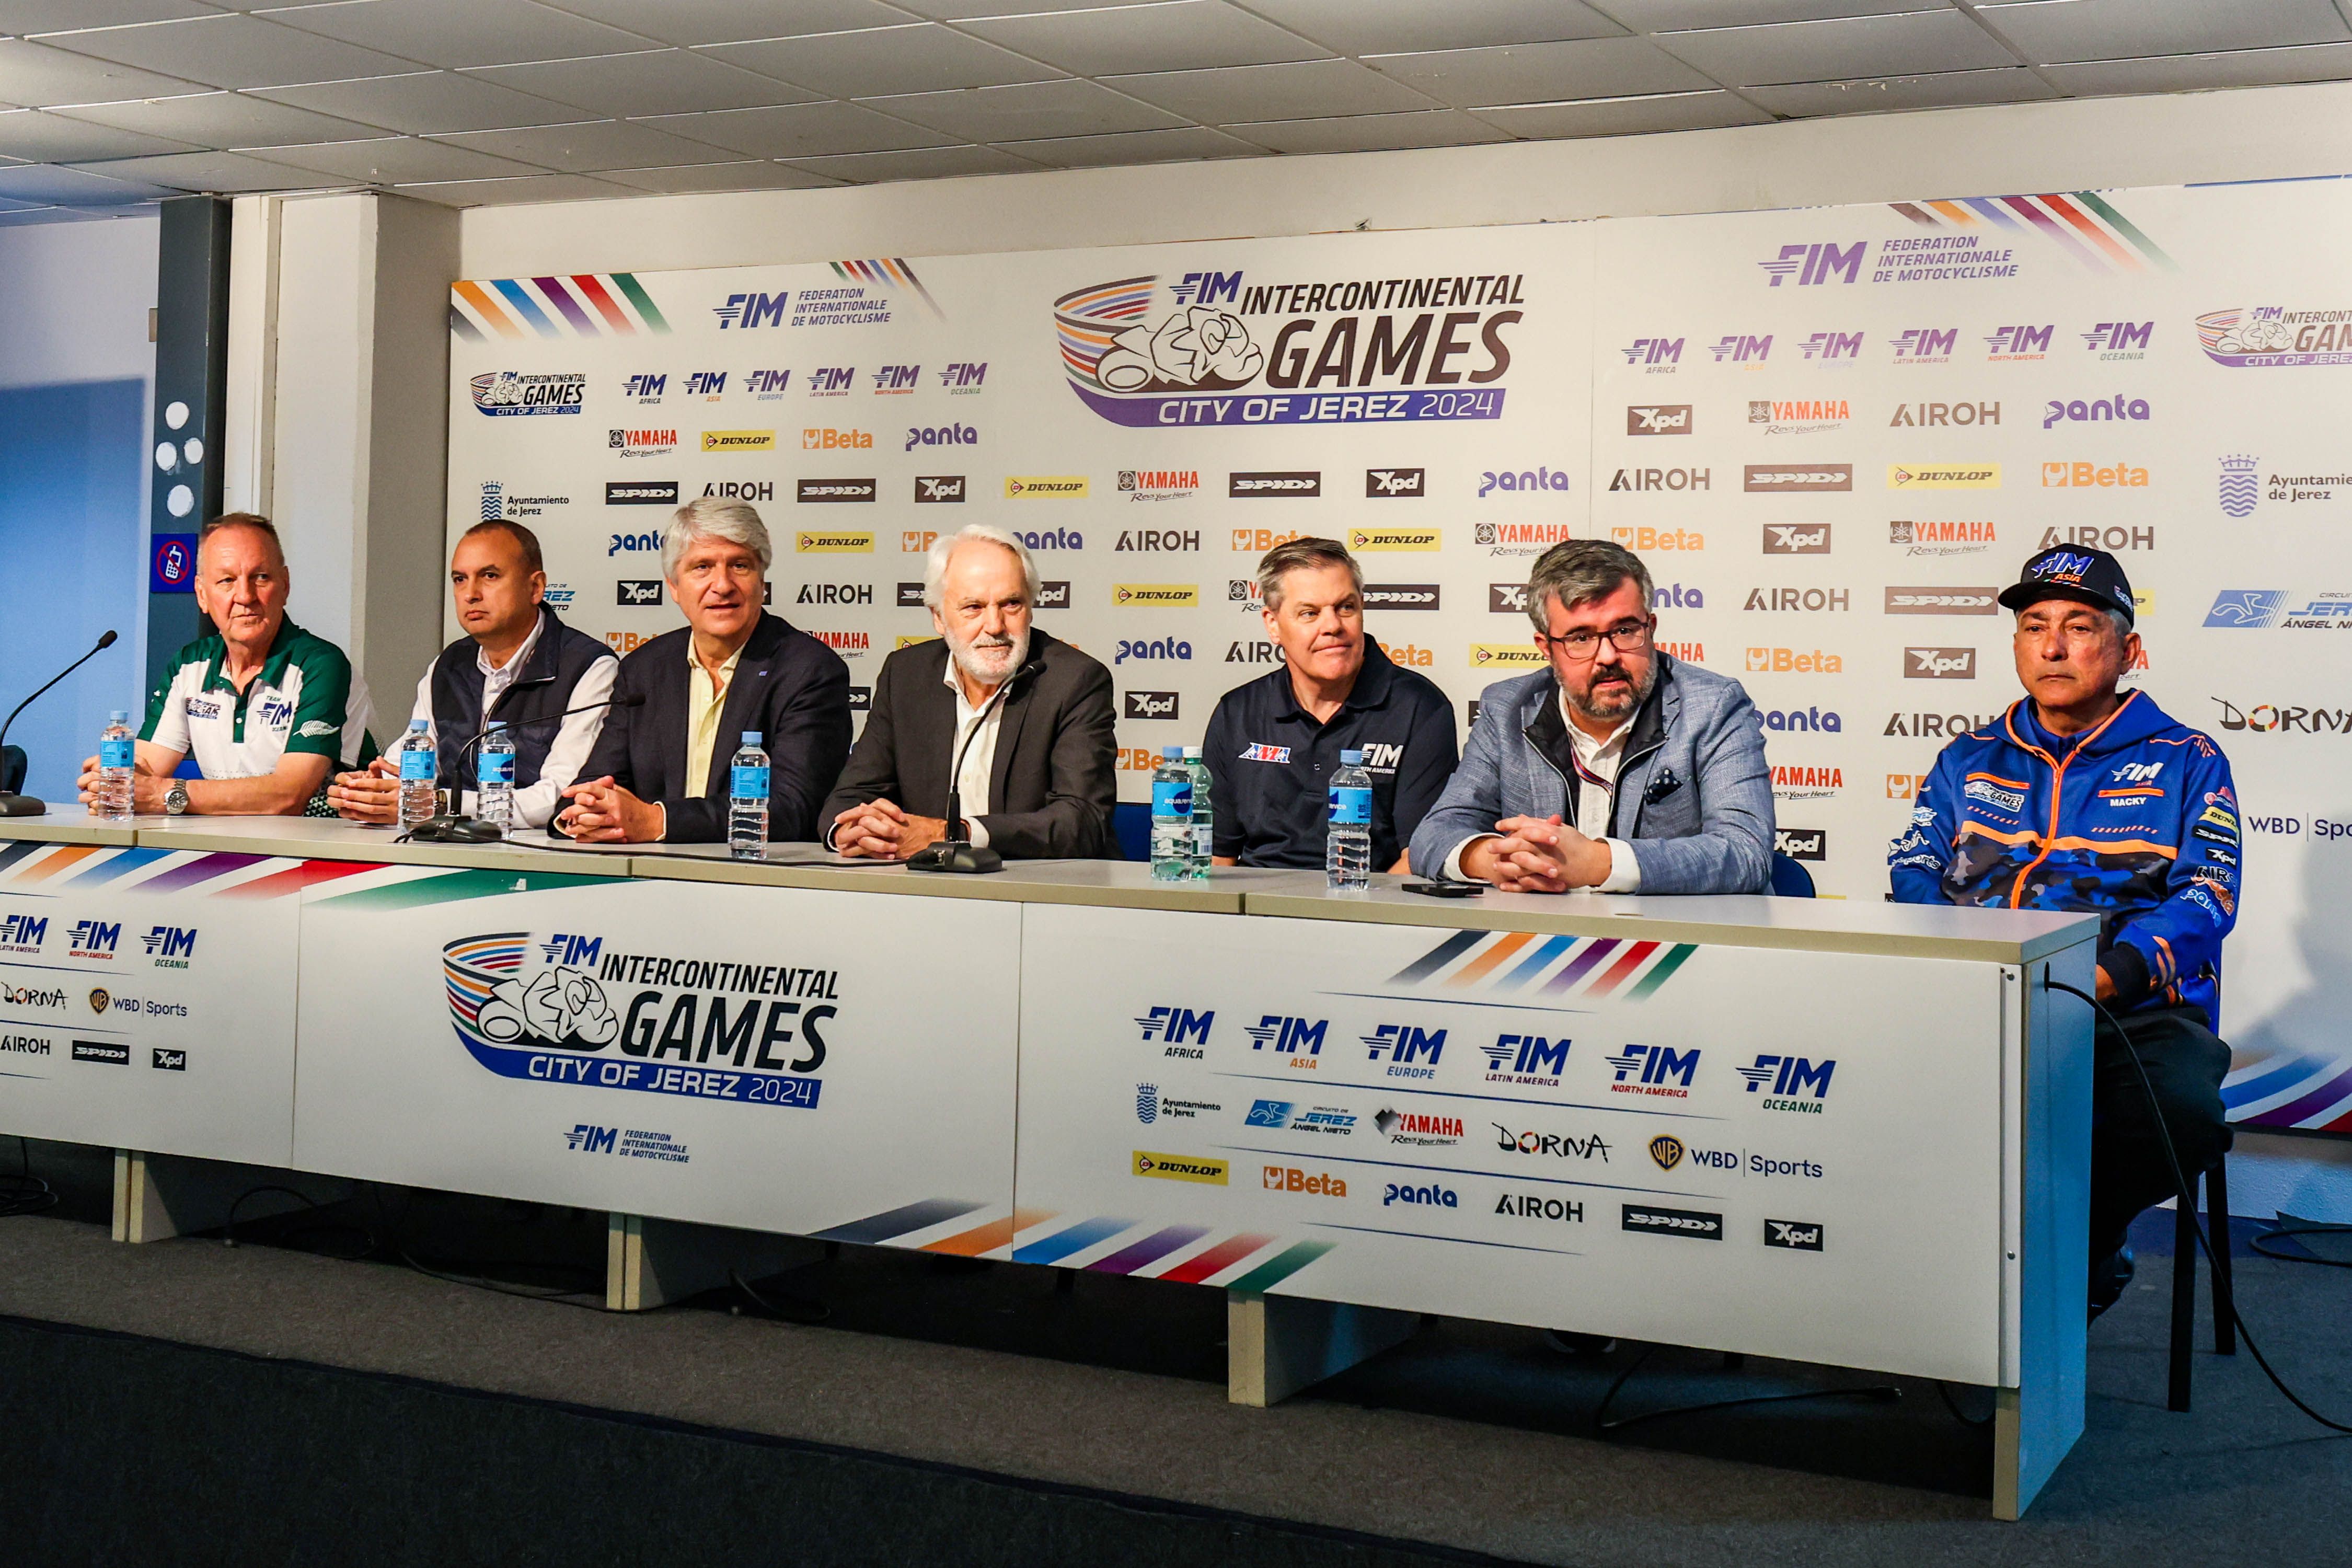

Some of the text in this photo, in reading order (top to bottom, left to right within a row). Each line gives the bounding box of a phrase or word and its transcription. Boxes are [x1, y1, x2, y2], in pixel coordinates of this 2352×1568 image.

[1883, 236, 1979, 251] FEDERATION
[1757, 241, 1867, 286] FIM
[1877, 249, 2012, 267] INTERNATIONALE
[1872, 265, 2018, 282] DE MOTOCYCLISME
[799, 288, 864, 300] FEDERATION
[1168, 271, 1525, 315] FIM INTERCONTINENTAL
[712, 292, 788, 329] FIM
[795, 299, 887, 314] INTERNATIONALE
[791, 313, 891, 326] DE MOTOCYCLISME
[1797, 332, 1864, 359] FIM
[1888, 329, 1958, 356] FIM
[1983, 325, 2054, 353] FIM
[2080, 321, 2154, 350] FIM
[1265, 310, 1525, 389] GAMES
[1621, 338, 1685, 364] FIM
[1708, 335, 1773, 362] FIM
[2100, 352, 2144, 361] OCEANIA
[500, 372, 585, 384] FIM INTERCONTINENTAL
[683, 372, 728, 394] FIM
[743, 370, 790, 392] FIM
[806, 367, 855, 390] FIM
[871, 365, 920, 388] FIM
[937, 362, 988, 386] FIM
[523, 384, 586, 405] GAMES
[622, 374, 667, 396] FIM
[497, 407, 516, 416] CITY
[531, 406, 559, 414] JEREZ
[1158, 393, 1493, 423] CITY OF JEREZ 2024
[1772, 400, 1849, 420] YAMAHA
[1889, 401, 2000, 427] AIROH
[2043, 394, 2150, 429] panta
[1631, 408, 1688, 433] Xpd
[625, 430, 677, 446] YAMAHA
[823, 429, 873, 449] Beta
[905, 423, 977, 452] panta
[1137, 471, 1198, 489] YAMAHA
[1479, 467, 1568, 497] panta
[1609, 468, 1710, 491] AIROH
[1917, 471, 1992, 480] DUNLOP
[2072, 462, 2149, 487] Beta
[608, 489, 675, 498] SPIDI
[1027, 482, 1083, 491] DUNLOP
[1233, 480, 1316, 490] SPIDI
[507, 495, 569, 506] Ayuntamiento
[2268, 489, 2331, 502] de Jerez
[507, 506, 541, 516] de Jerez
[1115, 531, 1199, 551] AIROH
[1497, 525, 1570, 543] YAMAHA
[1637, 528, 1704, 550] Beta
[1915, 522, 1996, 541] YAMAHA
[816, 538, 870, 546] DUNLOP
[2055, 573, 2081, 582] ASIA
[620, 583, 660, 603] Xpd
[796, 584, 872, 604] AIROH
[1135, 591, 1192, 599] DUNLOP
[1744, 588, 1849, 612] AIROH
[2281, 618, 2332, 628] ÁNGEL
[1115, 636, 1191, 664] panta
[1773, 648, 1842, 673] Beta
[1128, 694, 1174, 717] Xpd
[1769, 766, 1843, 787] YAMAHA
[2111, 762, 2164, 782] FIM
[1990, 792, 2021, 807] GAMES
[2110, 797, 2147, 806] MACKY
[2249, 816, 2300, 834] WBD
[1774, 832, 1820, 857] Xpd
[0, 915, 49, 945] FIM
[66, 920, 121, 951] FIM
[140, 926, 197, 958] FIM
[155, 959, 189, 970] OCEANIA
[539, 934, 838, 1000] FIM INTERCONTINENTAL
[1, 982, 68, 1010] DORNA
[113, 997, 187, 1017] WBD Sports
[620, 991, 837, 1073] GAMES
[1134, 1006, 1215, 1045] FIM
[1243, 1015, 1329, 1055] FIM
[75, 1047, 128, 1058] SPIDI
[1165, 1047, 1203, 1060] AFRICA
[1359, 1024, 1448, 1065] FIM
[156, 1051, 183, 1068] Xpd
[1289, 1058, 1317, 1069] ASIA
[1479, 1034, 1572, 1076] FIM
[1387, 1066, 1435, 1079] EUROPE
[1604, 1044, 1701, 1087] FIM
[528, 1056, 811, 1105] CITY OF JEREZ 2024
[1485, 1073, 1559, 1087] LATIN AMERICA
[1735, 1055, 1837, 1098] FIM
[1611, 1083, 1688, 1098] NORTH AMERICA
[1162, 1098, 1221, 1112] Ayuntamiento
[1162, 1106, 1195, 1119] de Jerez
[1762, 1099, 1823, 1114] OCEANIA
[1290, 1123, 1352, 1135] ÁNGEL NIETO
[1294, 1112, 1357, 1126] JEREZ
[1396, 1113, 1463, 1137] YAMAHA
[563, 1125, 618, 1154] FIM
[625, 1129, 672, 1142] FEDERATION
[1390, 1134, 1417, 1145] Revs
[1417, 1136, 1436, 1146] Your
[1491, 1122, 1613, 1163] DORNA
[619, 1148, 689, 1163] DE MOTOCYCLISME
[622, 1138, 687, 1154] INTERNATIONALE
[1157, 1161, 1222, 1176] DUNLOP
[1691, 1149, 1823, 1178] WBD Sports
[1286, 1168, 1346, 1197] Beta
[1383, 1183, 1458, 1208] panta
[1495, 1194, 1583, 1223] AIROH
[1627, 1213, 1718, 1231] SPIDI
[1768, 1221, 1818, 1246] Xpd
